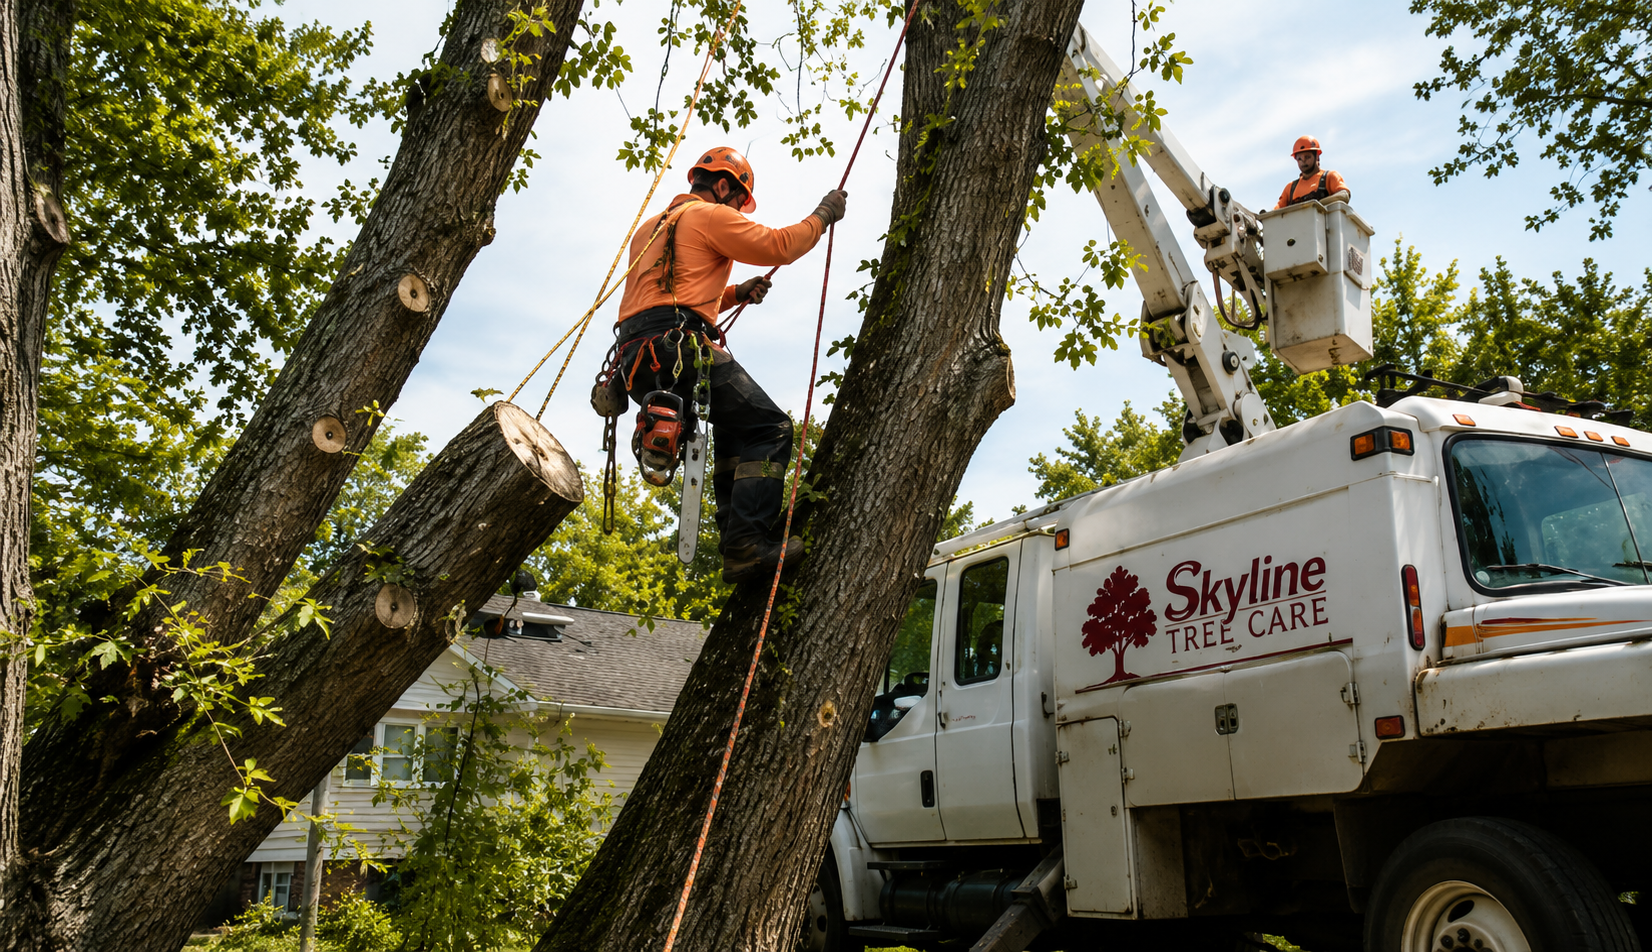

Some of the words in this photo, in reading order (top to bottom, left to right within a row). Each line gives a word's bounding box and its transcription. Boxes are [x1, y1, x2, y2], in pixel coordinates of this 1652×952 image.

[1164, 555, 1326, 624] Skyline
[1165, 620, 1234, 654] TREE
[1248, 597, 1329, 638] CARE
